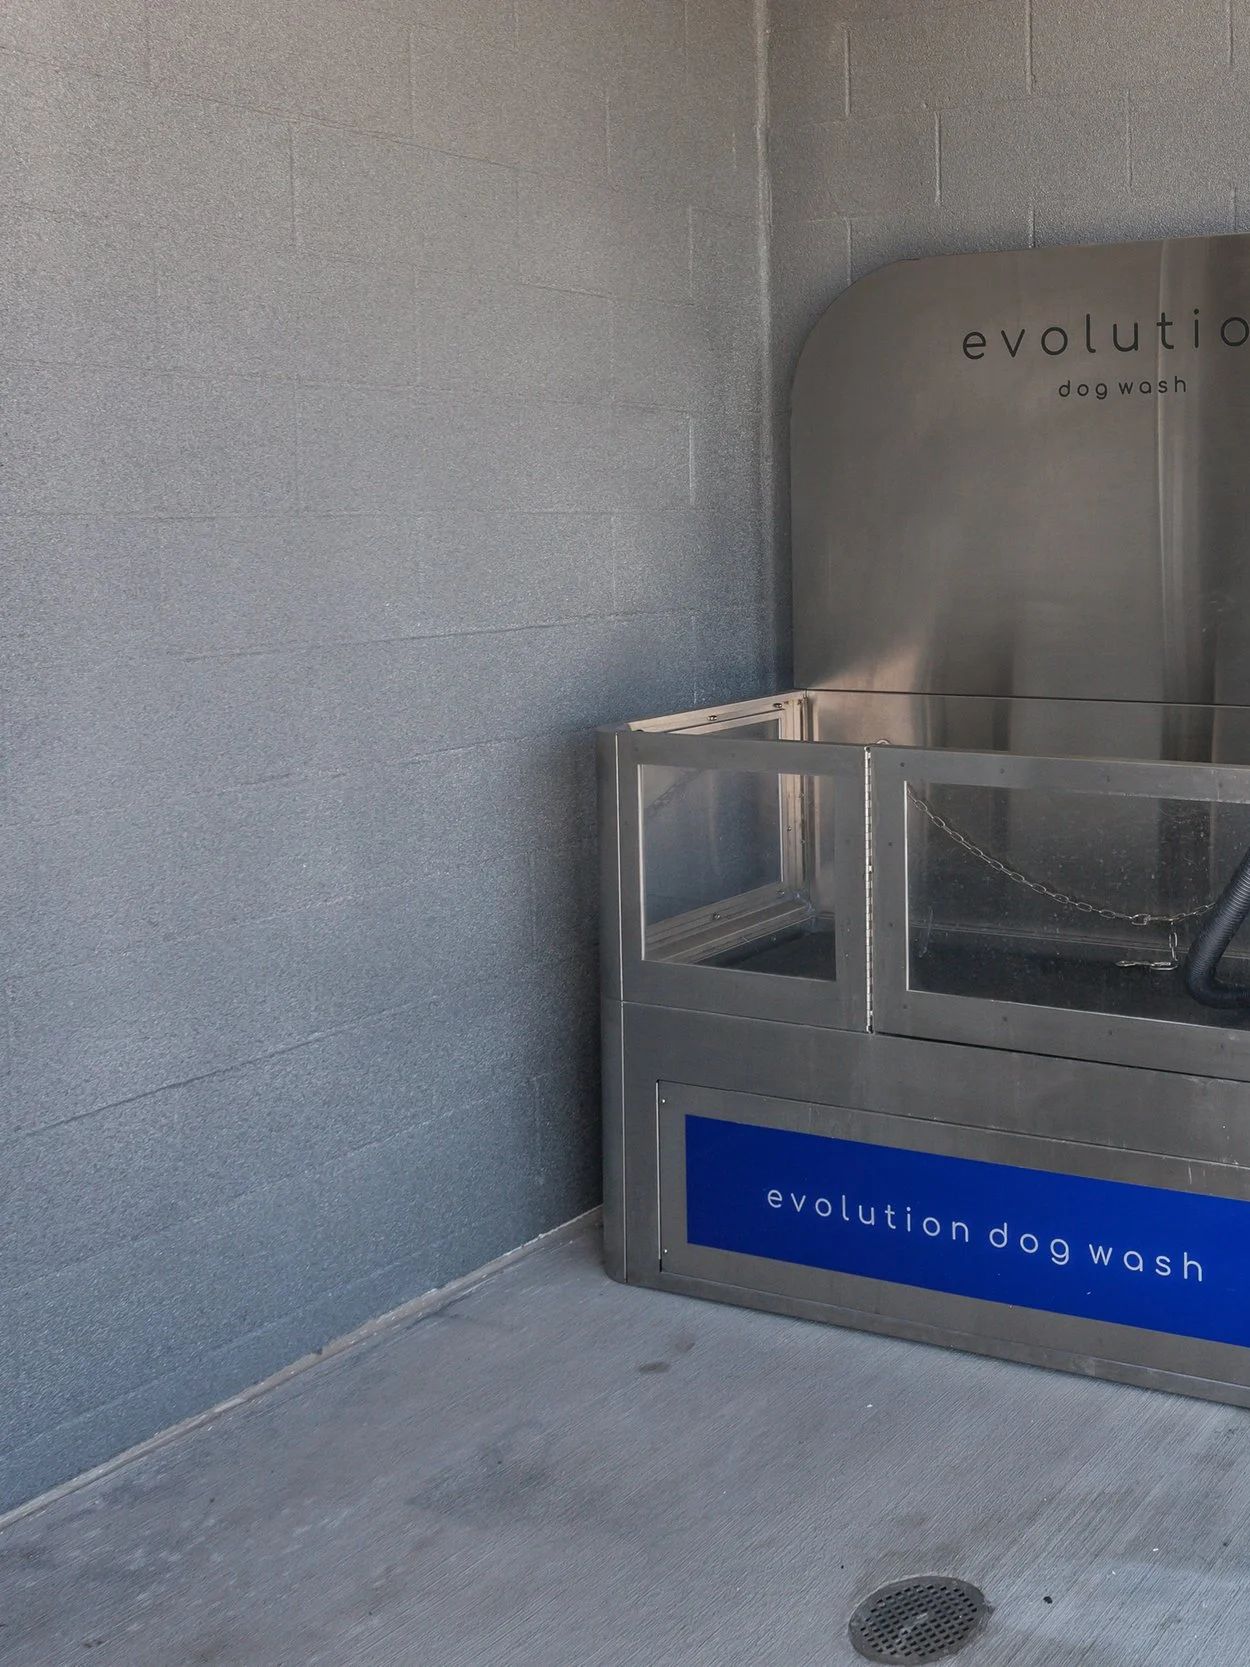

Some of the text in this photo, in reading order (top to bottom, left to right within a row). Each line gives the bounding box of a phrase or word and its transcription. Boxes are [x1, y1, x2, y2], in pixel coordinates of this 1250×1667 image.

[1058, 376, 1187, 400] dog wash
[766, 1187, 1204, 1283] evolution dog wash
